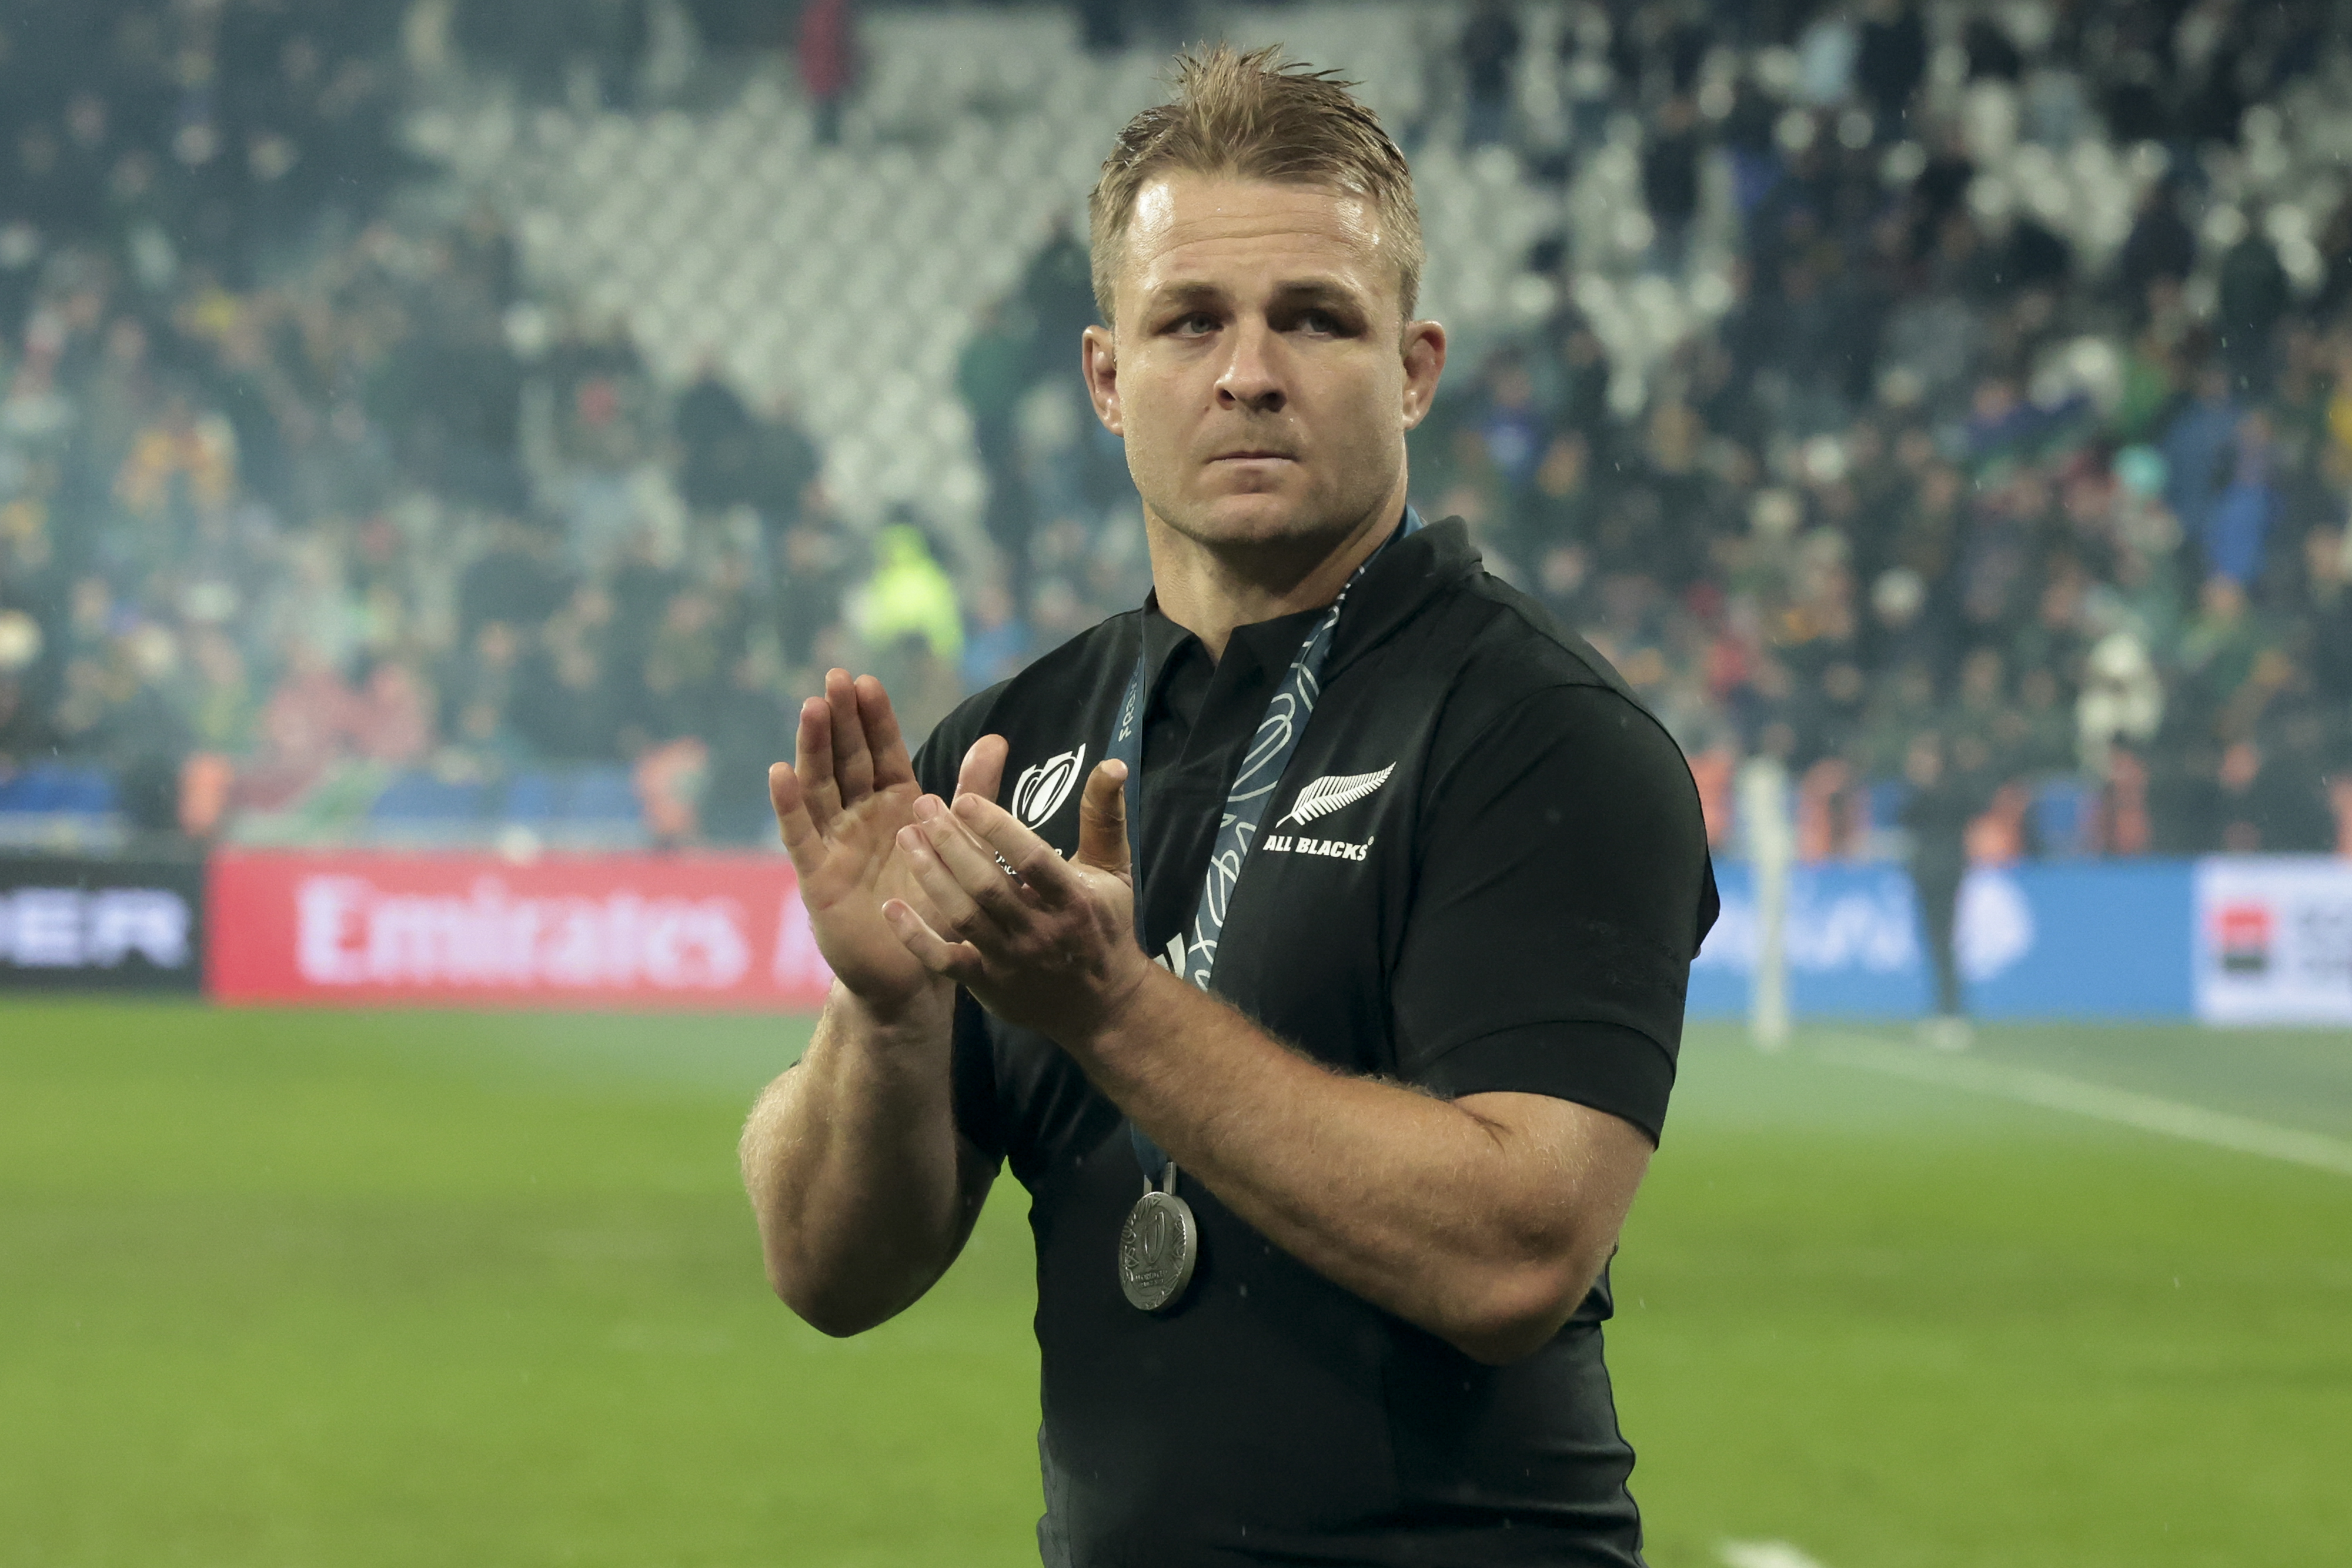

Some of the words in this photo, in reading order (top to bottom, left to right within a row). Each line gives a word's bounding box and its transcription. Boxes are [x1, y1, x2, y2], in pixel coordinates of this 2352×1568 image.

[1263, 835, 1292, 851] ALL
[1295, 837, 1368, 861] BLACKS
[0, 887, 189, 968] ER
